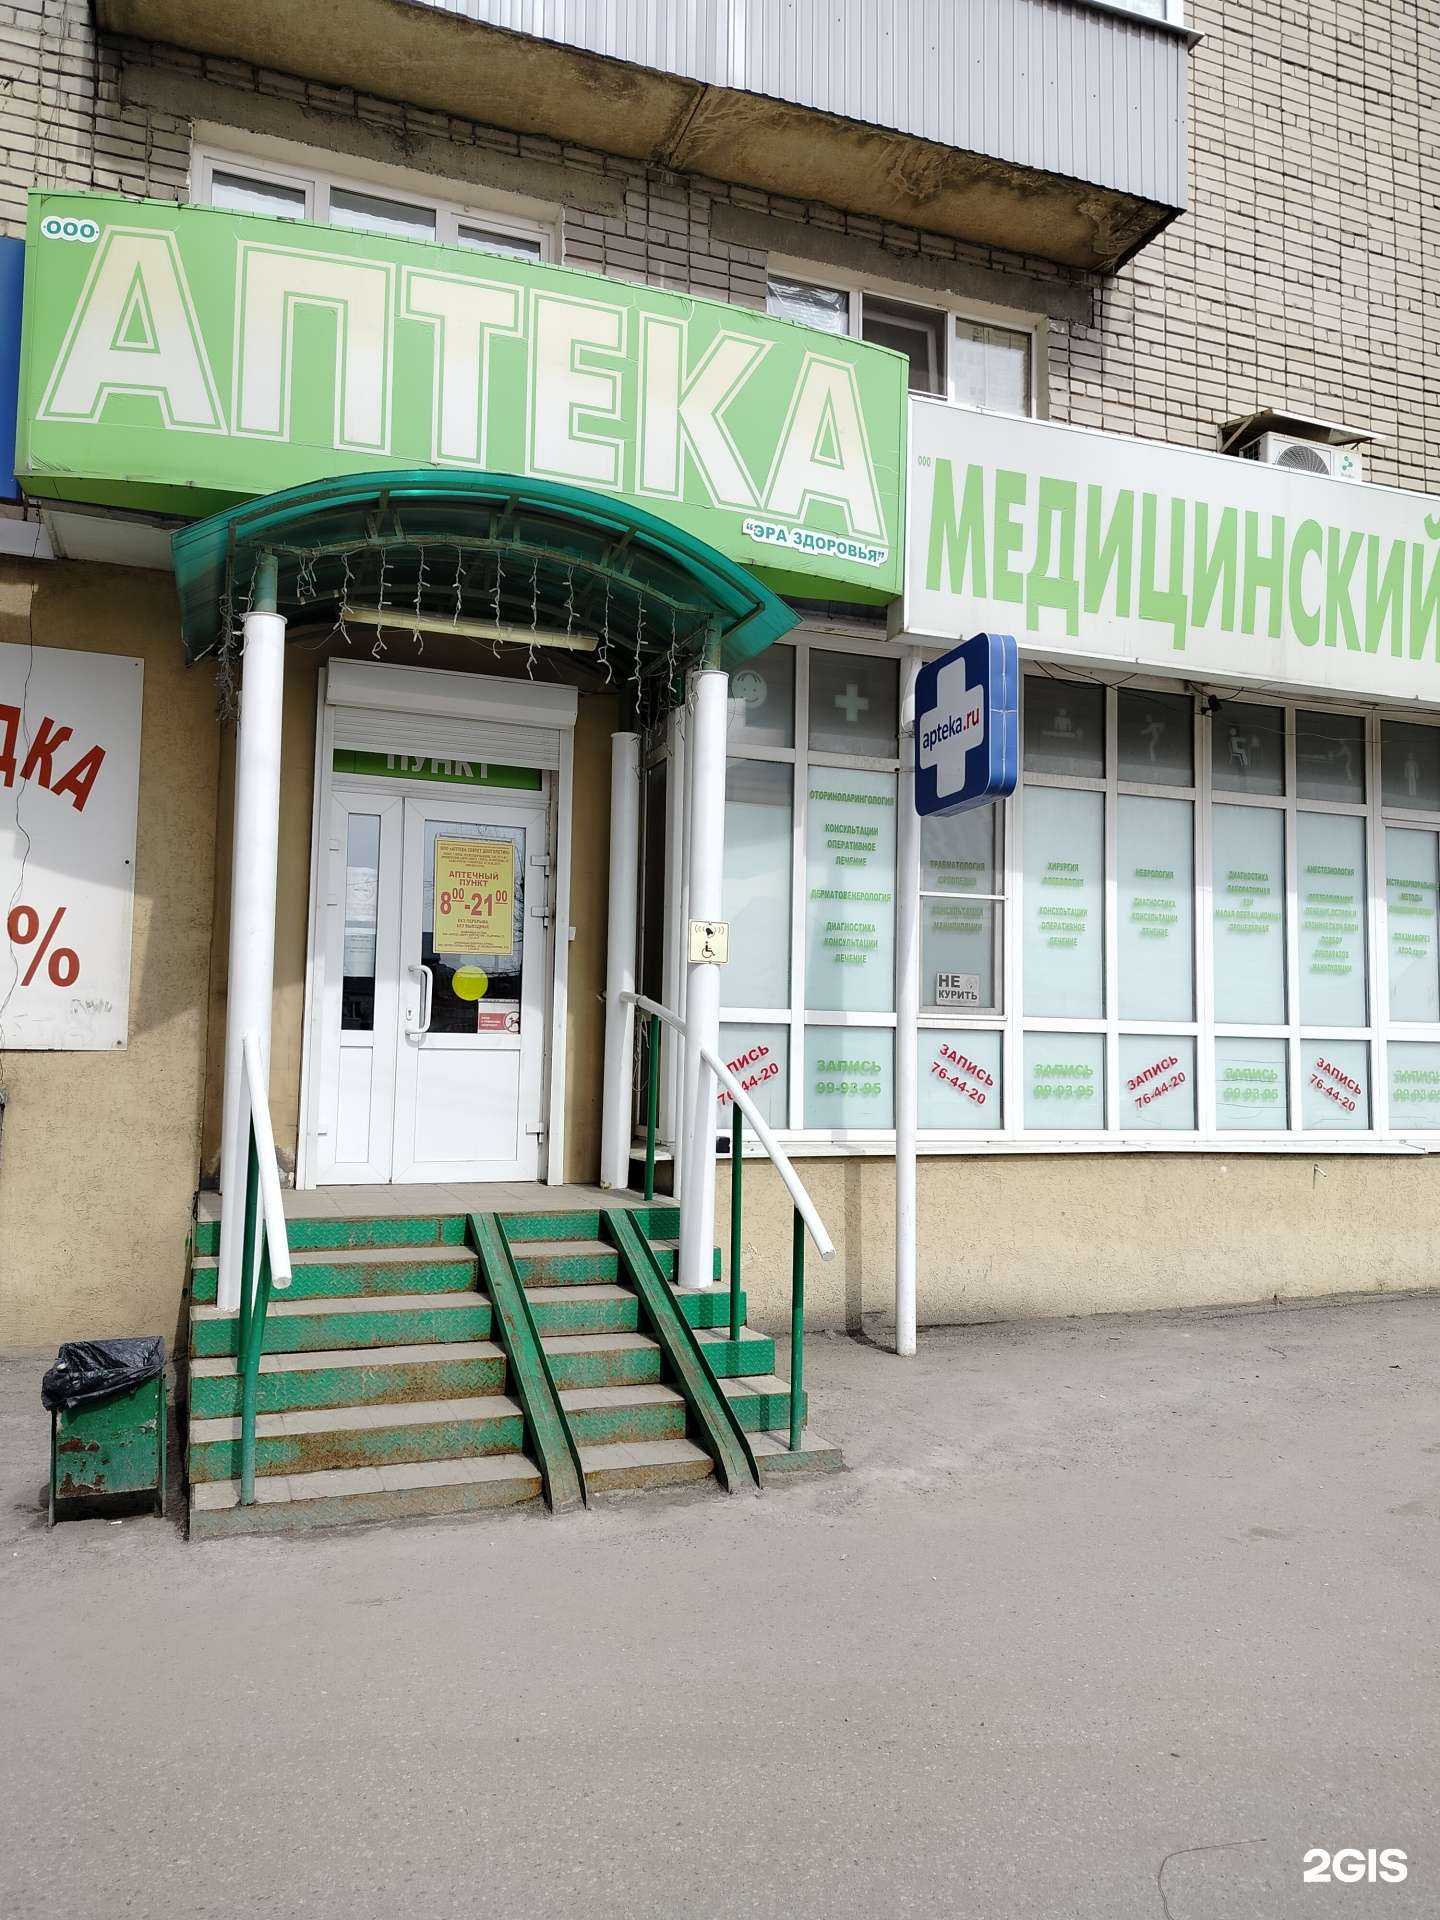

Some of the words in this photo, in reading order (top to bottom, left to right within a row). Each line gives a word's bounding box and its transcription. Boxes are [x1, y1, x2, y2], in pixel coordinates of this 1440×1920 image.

[46, 220, 95, 238] ООО
[35, 225, 888, 544] АПТЕКА
[925, 457, 1440, 663] МЕДИЦИНСКИЙ
[922, 708, 980, 751] apteka.ru
[825, 823, 879, 837] КОНСУЛЬТАЦИИ
[827, 839, 876, 851] ОПЕРАТИВНОЕ
[448, 870, 499, 881] АПТЕЧНЫЙ
[459, 879, 488, 887] ПУНКТ
[938, 974, 960, 988] НЕ
[938, 989, 978, 1001] КУРИТЬ
[726, 1045, 770, 1074] ПИСЬ
[816, 1059, 882, 1074] ЗАПИСЬ
[939, 1043, 995, 1088] ЗАПИСЬ
[1126, 1055, 1179, 1091] ЗАПИСЬ
[1315, 1056, 1362, 1095] ЗАПИСЬ
[930, 1061, 986, 1106] 76-44-20
[1134, 1071, 1186, 1109] 76-44-20
[1310, 1073, 1356, 1113] 76-44-20
